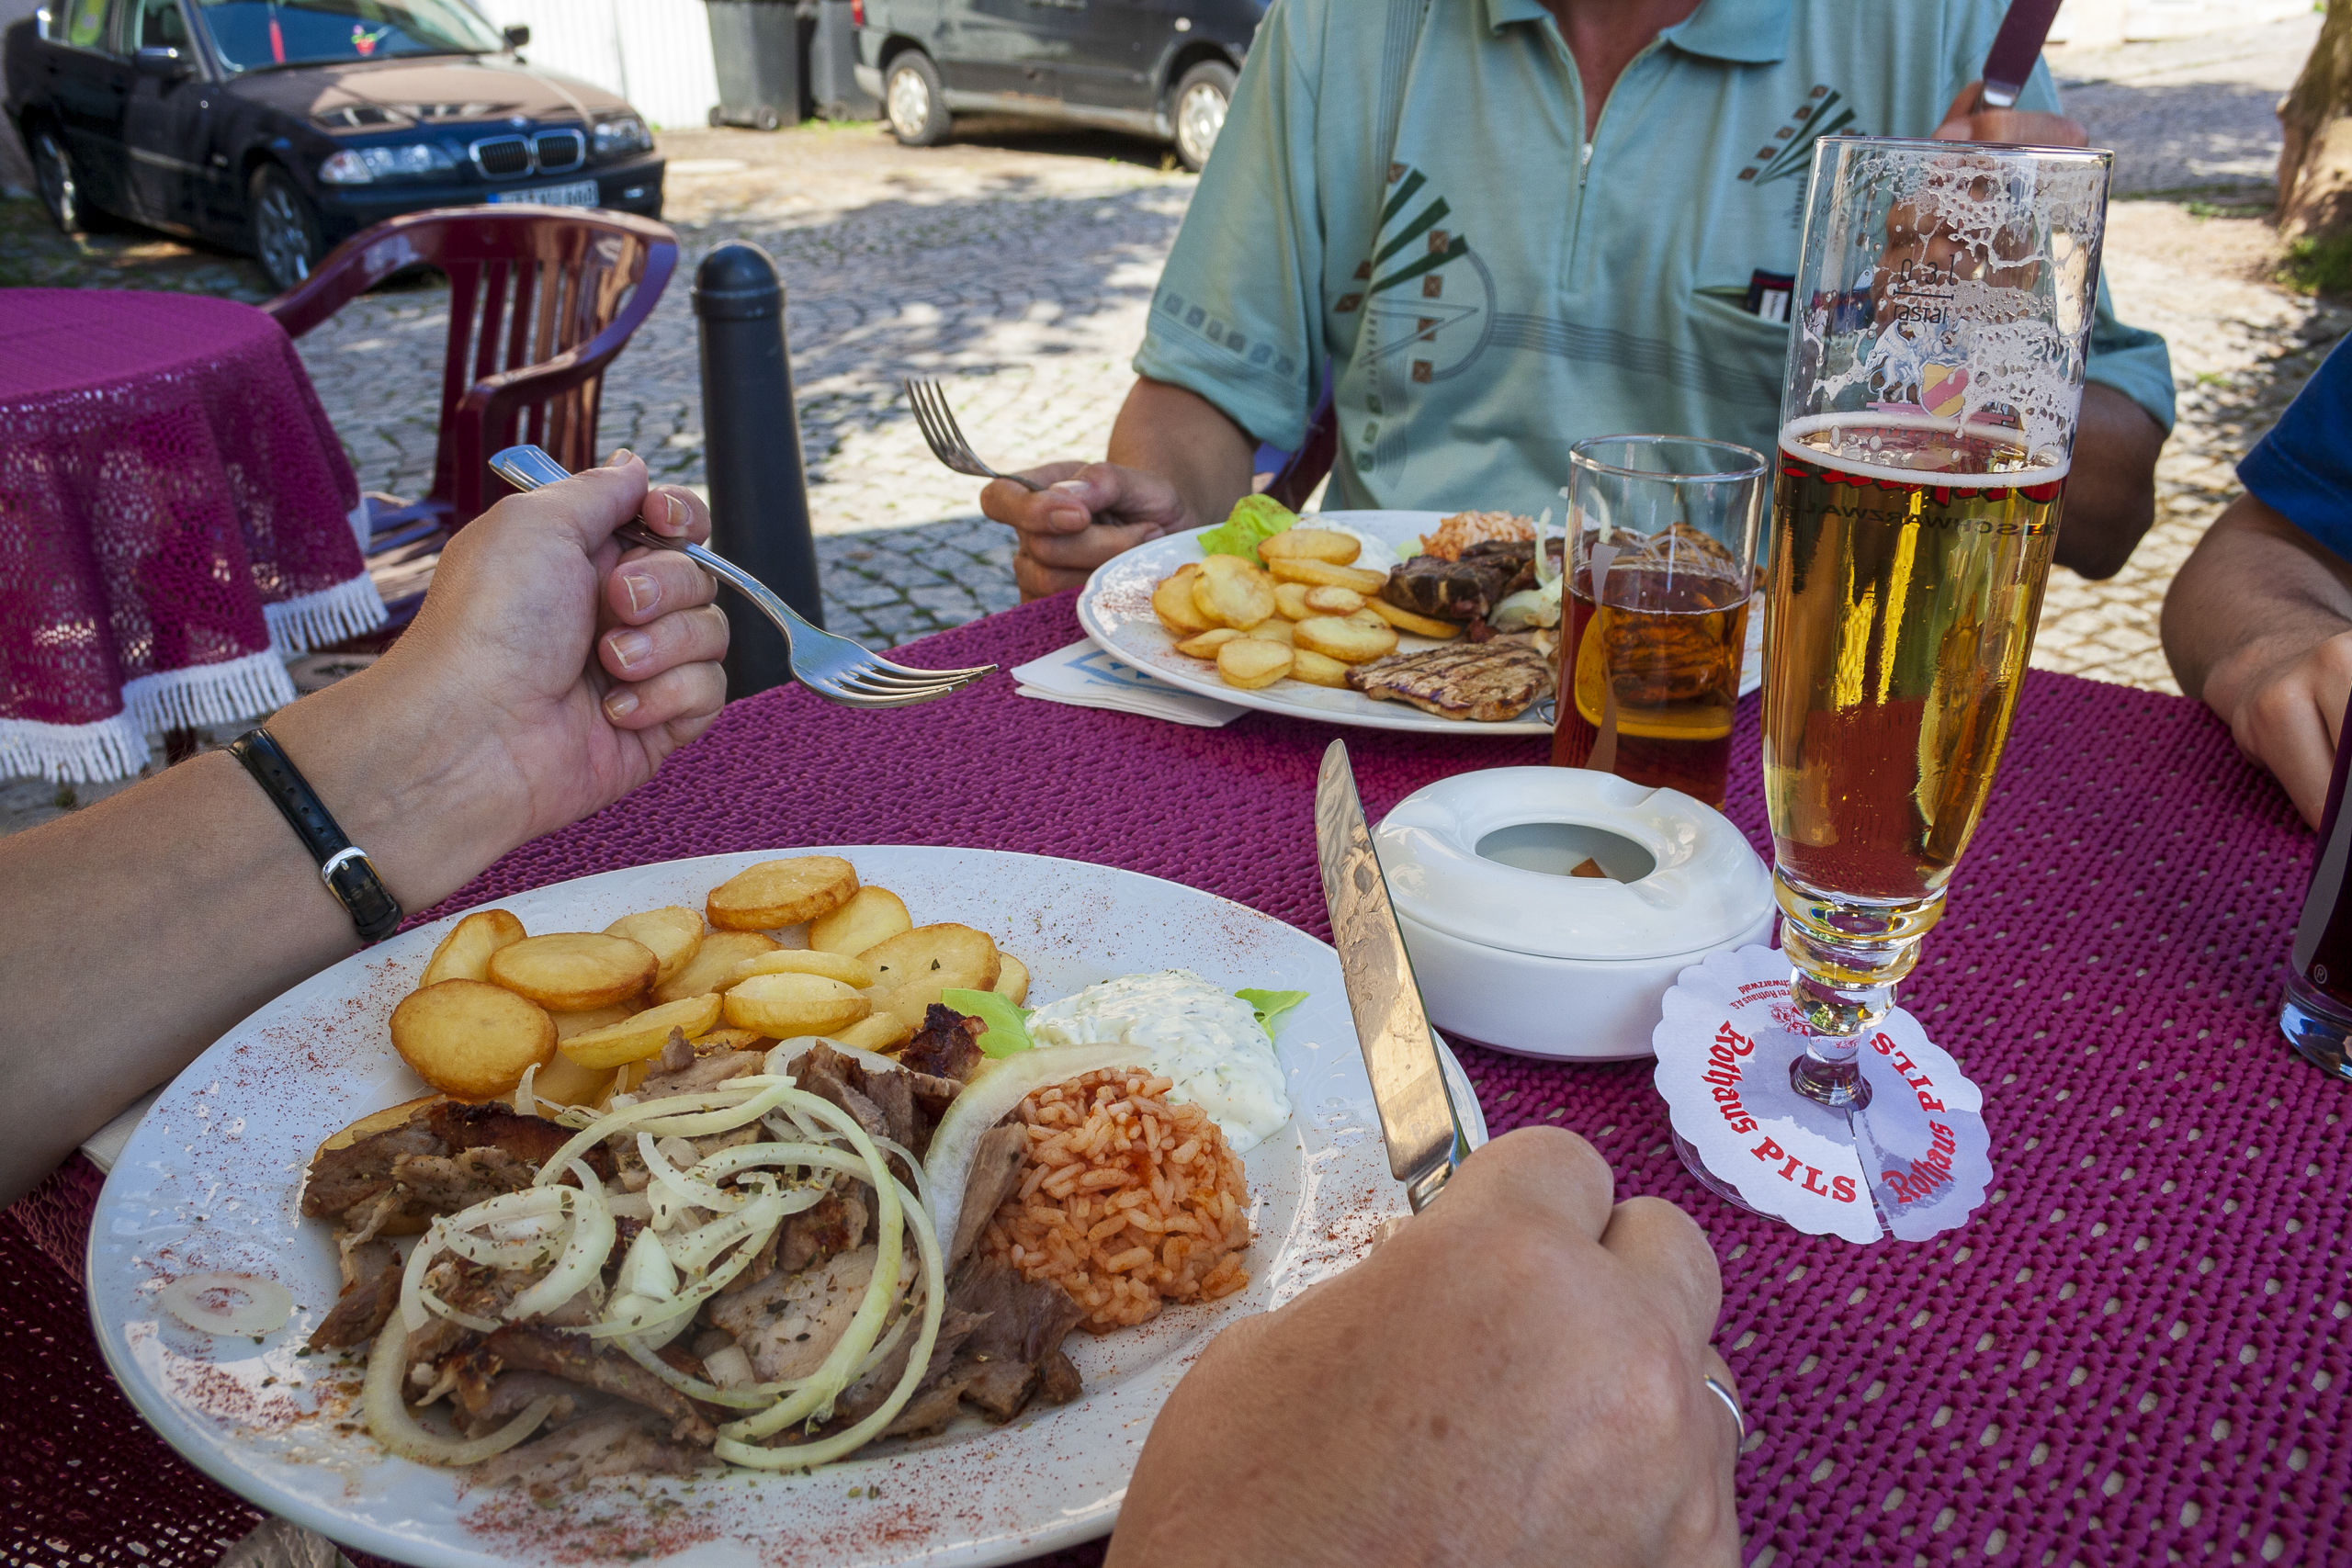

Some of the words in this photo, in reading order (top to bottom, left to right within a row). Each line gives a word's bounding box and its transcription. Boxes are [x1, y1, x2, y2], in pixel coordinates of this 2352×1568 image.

[1894, 304, 1948, 324] rastal
[1737, 979, 1790, 995] chwarzwald
[1742, 989, 1779, 1004] Rothaus
[1870, 1032, 1946, 1113] PILS
[1701, 1020, 1758, 1134] Rothaus
[1750, 1135, 1857, 1203] PILS
[1881, 1119, 1957, 1204] Rothaus
